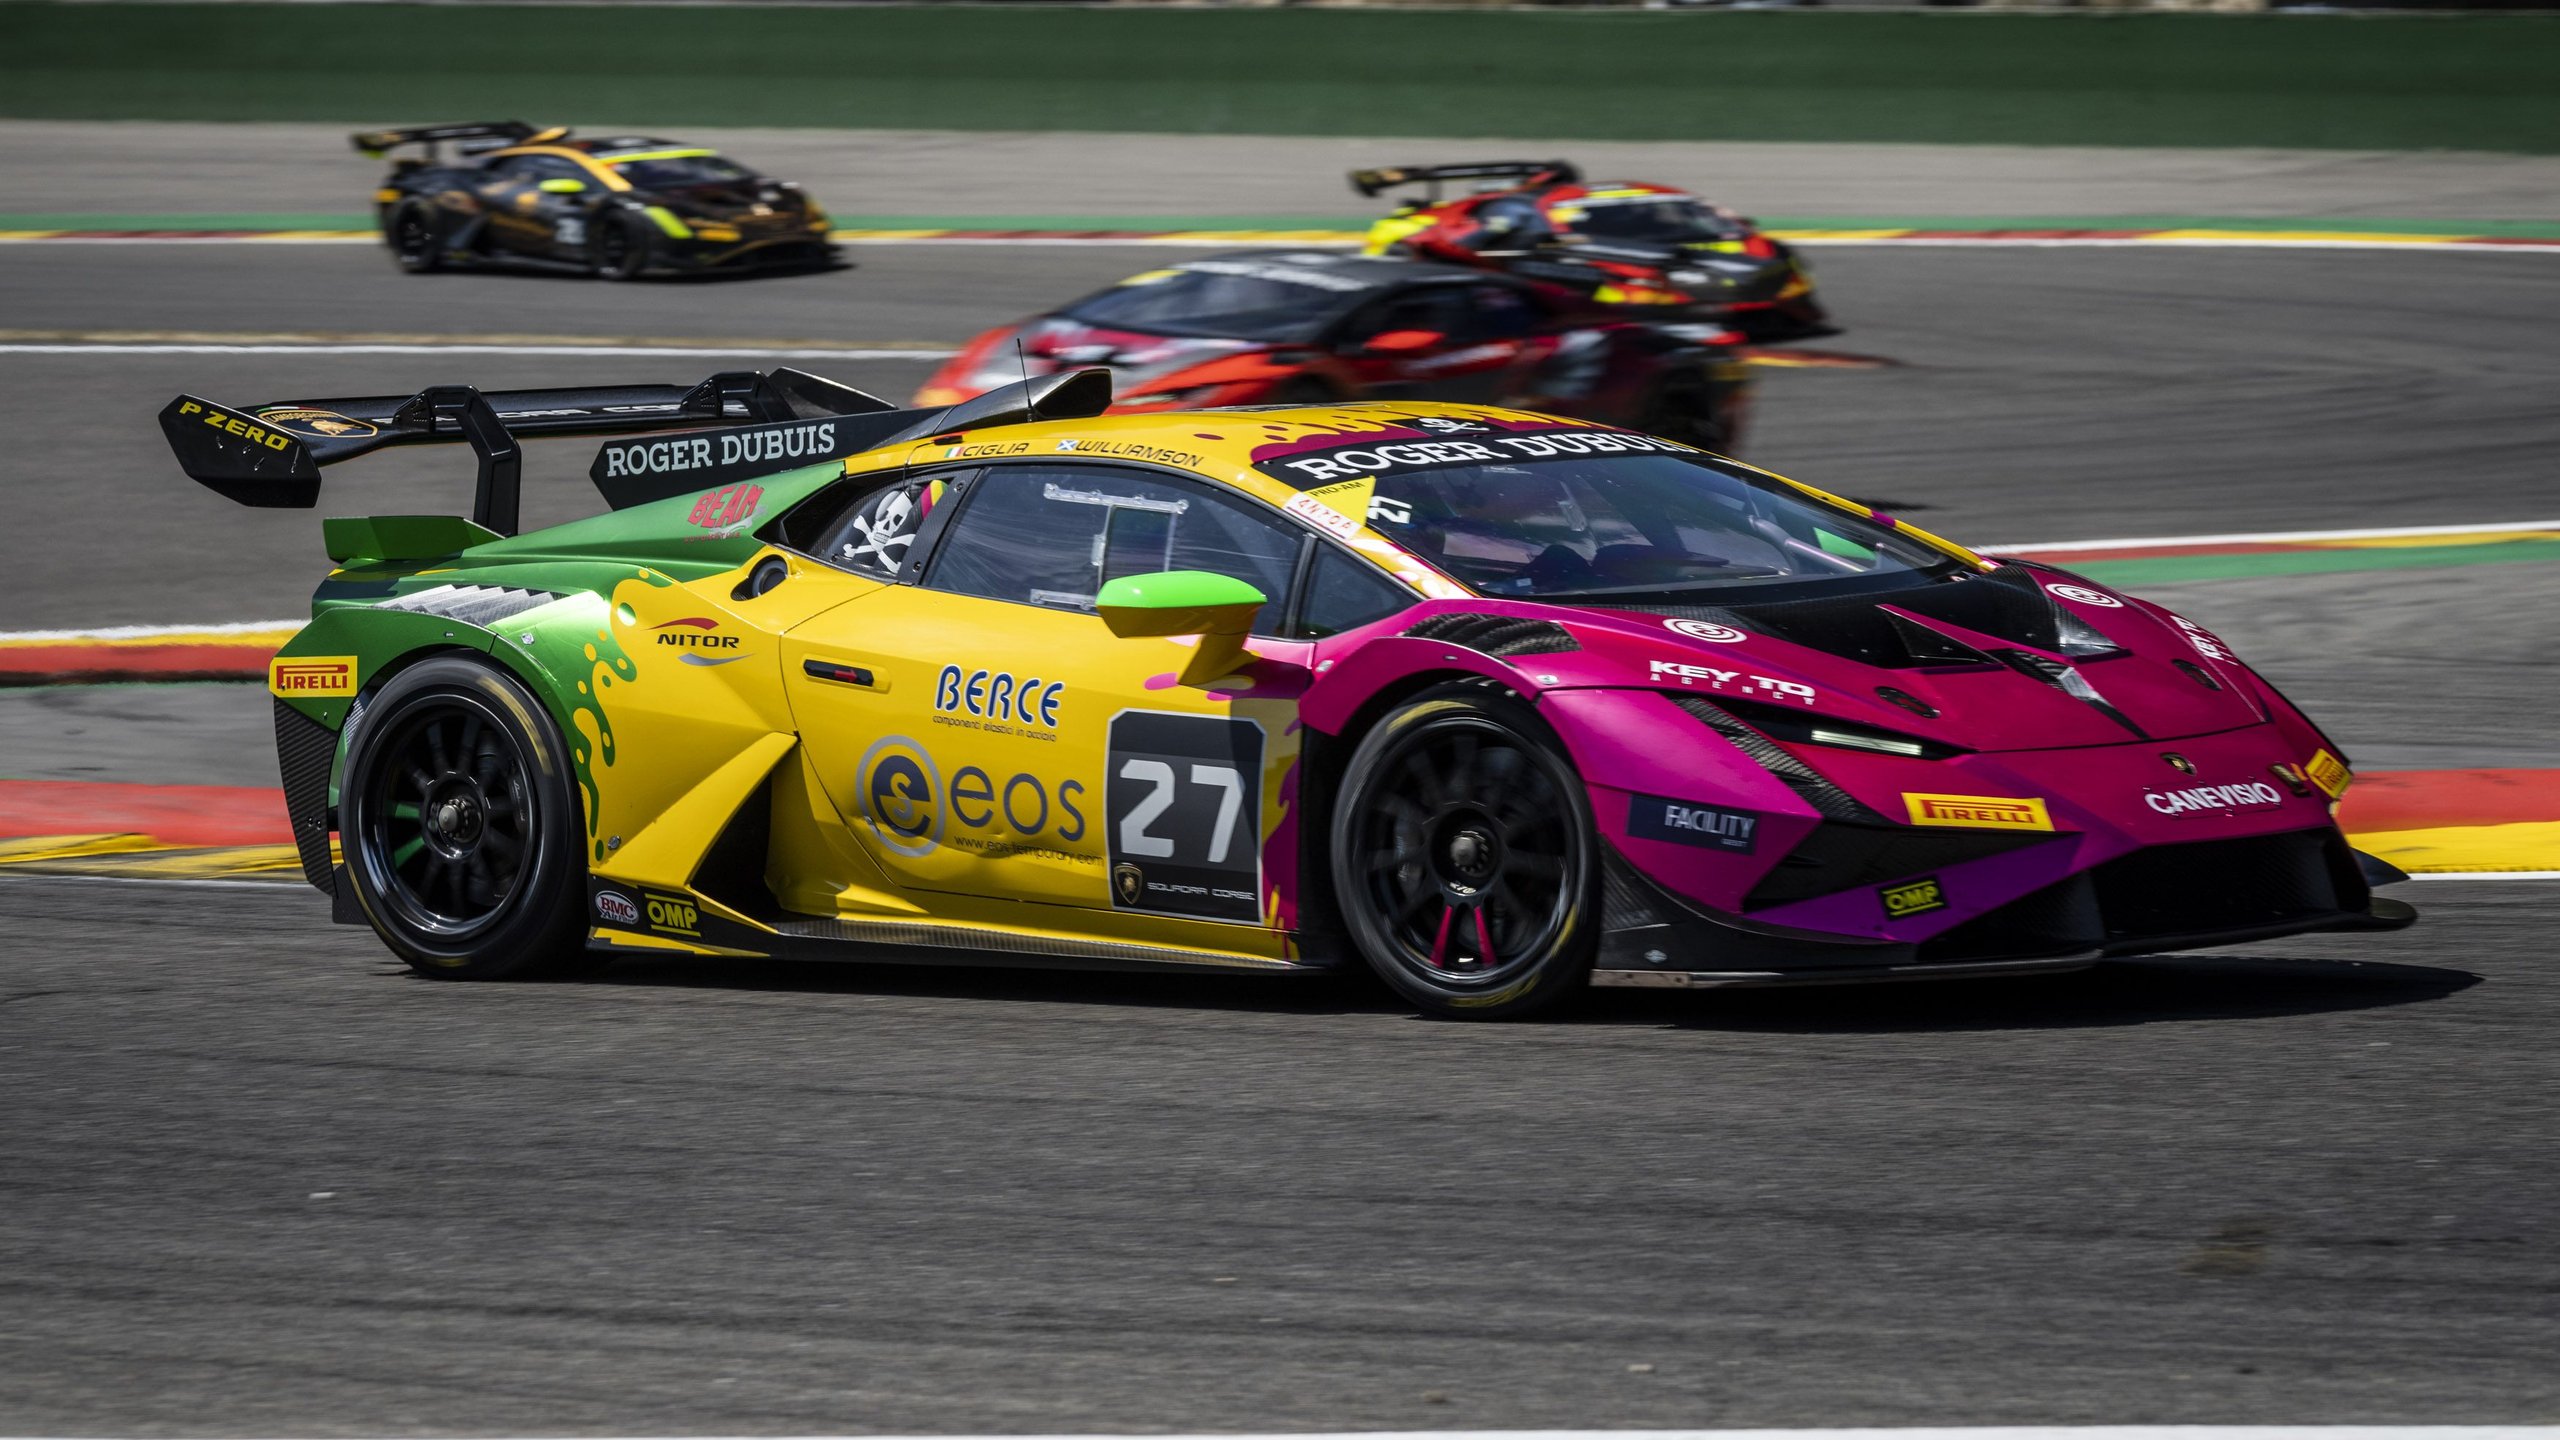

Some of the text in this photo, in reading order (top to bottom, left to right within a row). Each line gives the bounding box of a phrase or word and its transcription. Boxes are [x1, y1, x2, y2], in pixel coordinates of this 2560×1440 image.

[179, 401, 290, 451] P ZERO
[606, 423, 835, 477] ROGER DUBUIS
[962, 442, 1030, 457] CIGLIA
[1075, 440, 1204, 467] WILLIAMSON
[1285, 440, 1512, 480] ROGER
[1310, 481, 1366, 497] PRO-AM
[1366, 495, 1412, 524] 27
[656, 633, 739, 648] NITOR
[276, 664, 349, 689] PIRELLI
[1649, 660, 1816, 697] KEY TO
[936, 664, 1064, 729] BERCE
[950, 765, 1086, 842] eos
[1119, 758, 1246, 863] 27
[1919, 799, 2037, 824] PIRELLI
[2144, 782, 2282, 814] CANEVISIO
[1664, 804, 1756, 838] FACILITY
[600, 896, 635, 919] BMC
[1885, 885, 1939, 910] OMP
[646, 900, 698, 929] OMP
